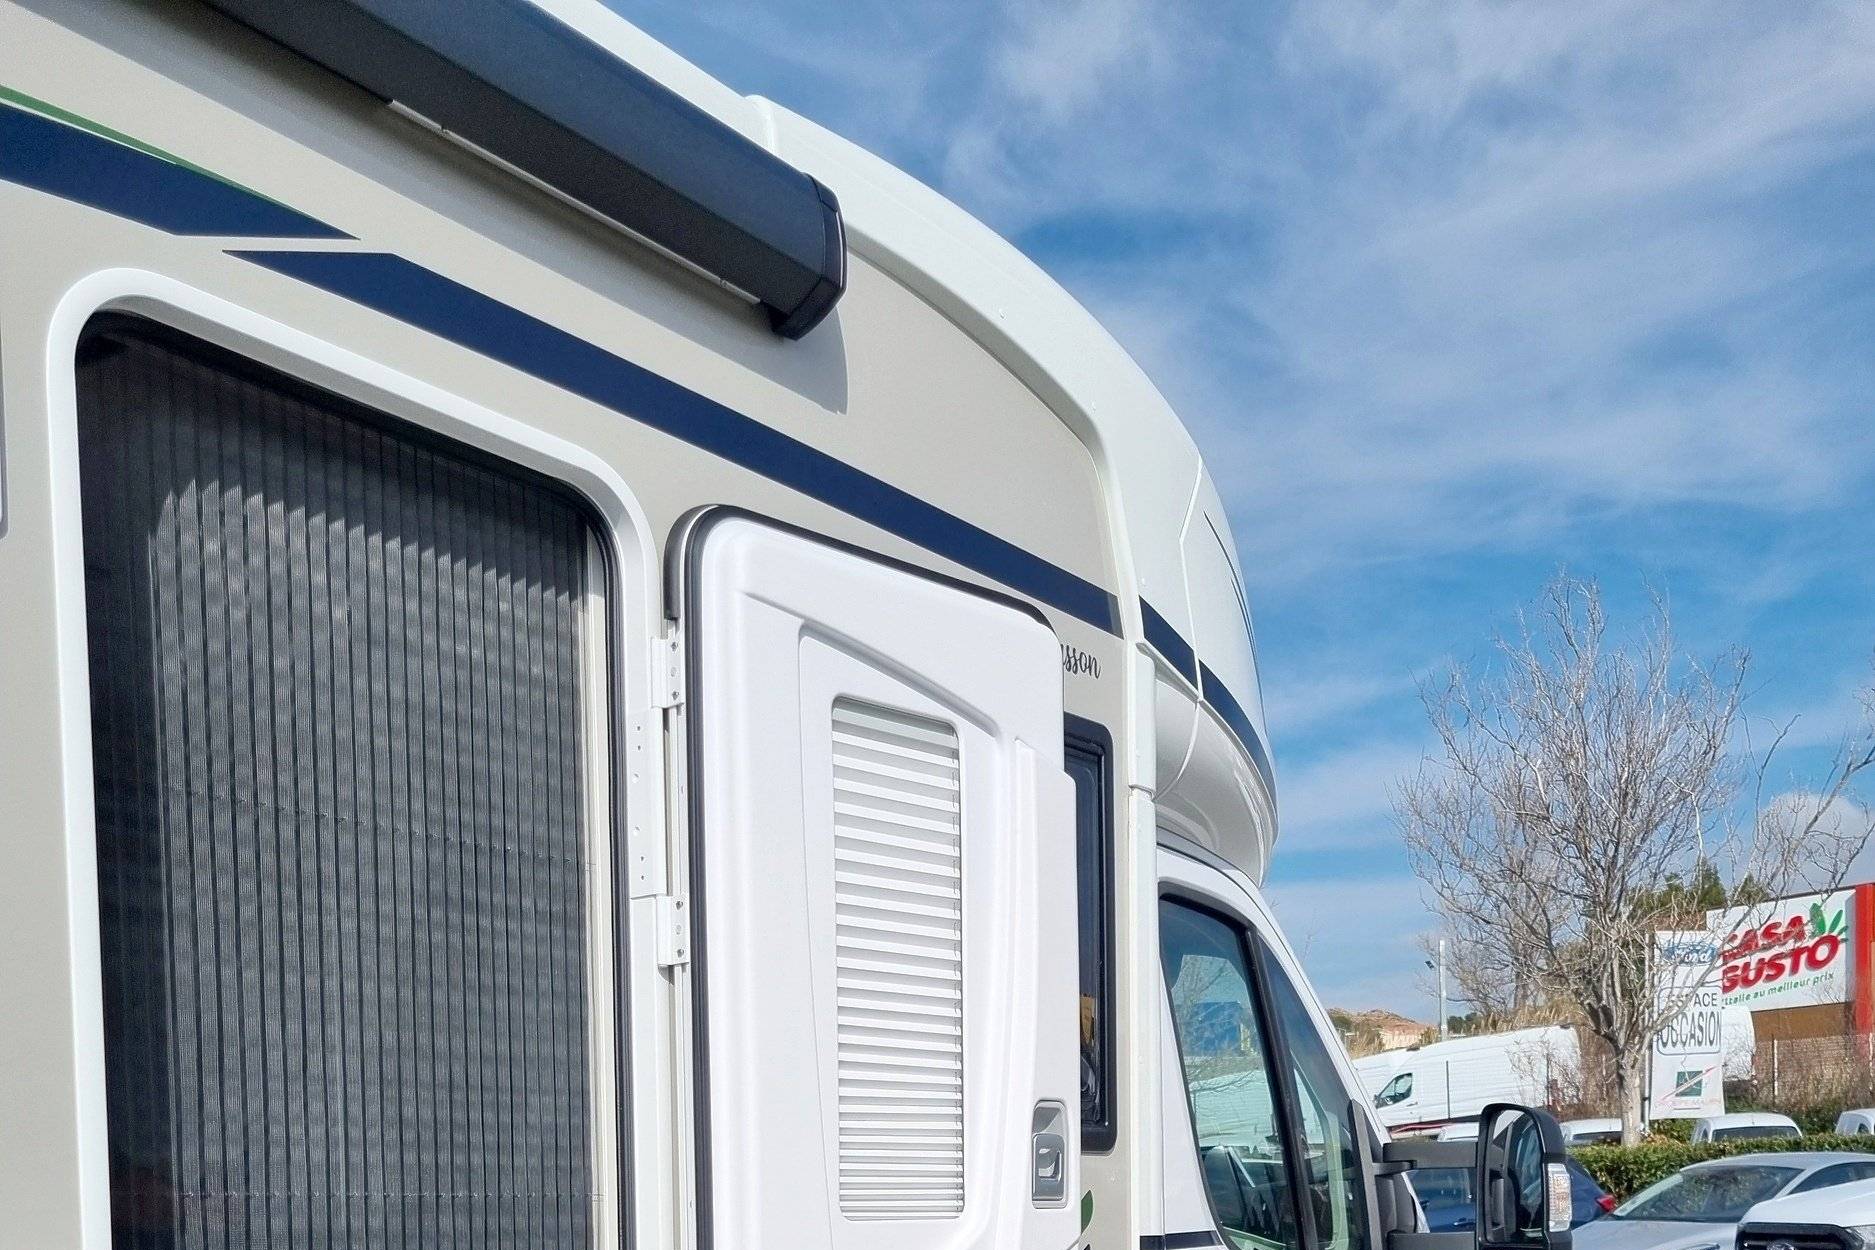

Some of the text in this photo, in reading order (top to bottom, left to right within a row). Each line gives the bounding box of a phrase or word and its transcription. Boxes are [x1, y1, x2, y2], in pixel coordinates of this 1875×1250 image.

[1061, 644, 1101, 679] sson
[1722, 934, 1840, 995] GUSTO
[1721, 971, 1835, 1007] 'Italie au meilleur prix
[1660, 1011, 1721, 1048] OCCASION
